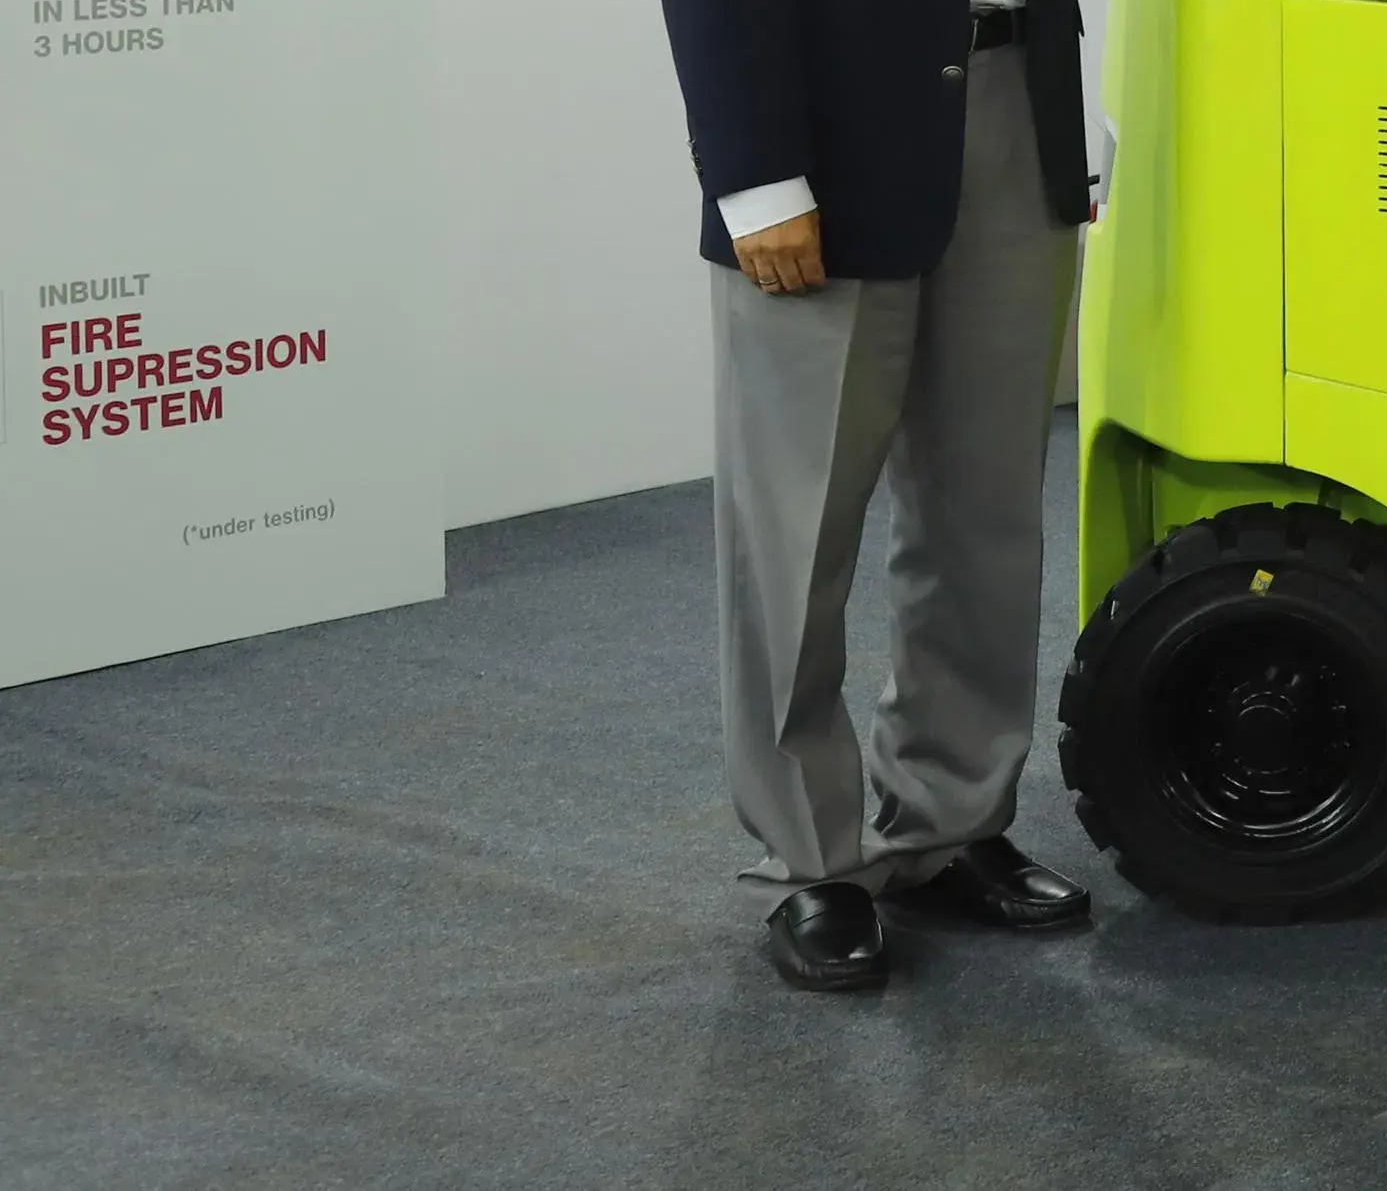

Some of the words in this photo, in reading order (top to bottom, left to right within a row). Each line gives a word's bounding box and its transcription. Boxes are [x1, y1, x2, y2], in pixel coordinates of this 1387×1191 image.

[33, 0, 63, 24] IN
[33, 35, 51, 58] 3
[62, 27, 164, 56] HOURS
[39, 273, 151, 309] INBUILT
[41, 312, 143, 359] FIRE
[41, 329, 327, 402] SUPRESSION
[41, 386, 224, 446] SYSTEM
[263, 498, 335, 529] testing)
